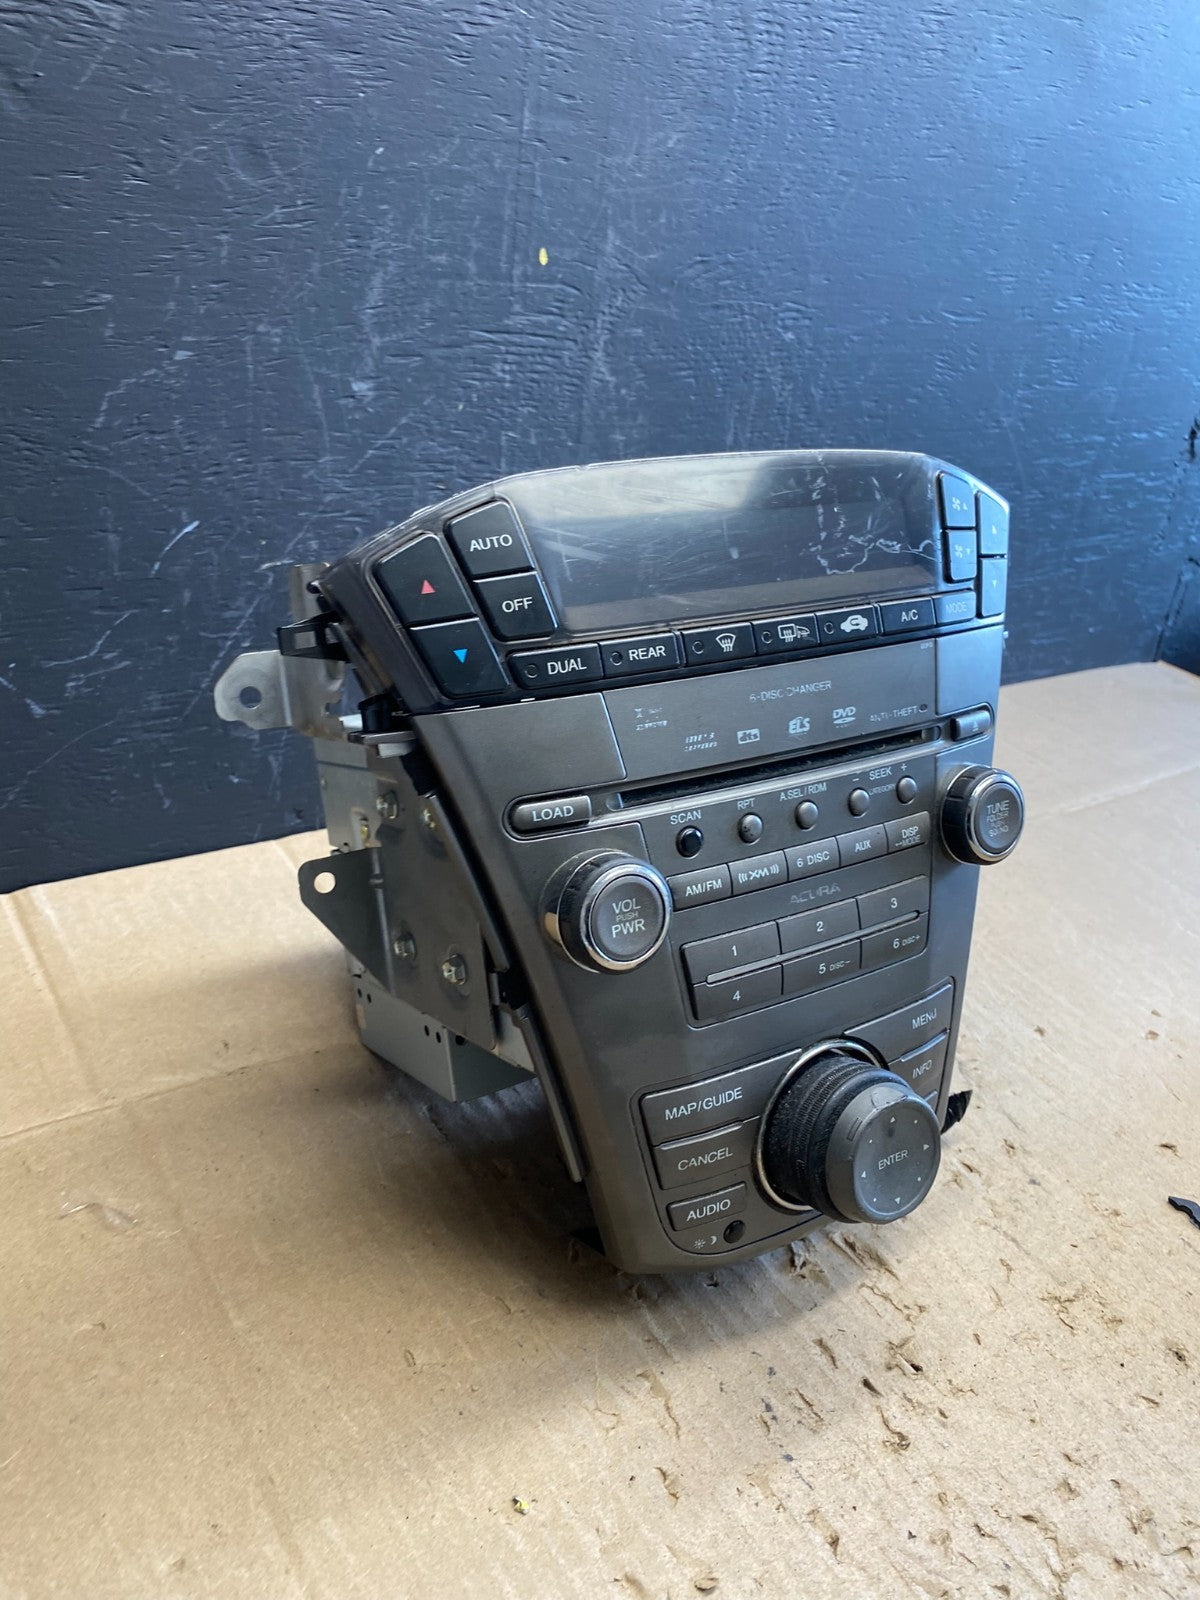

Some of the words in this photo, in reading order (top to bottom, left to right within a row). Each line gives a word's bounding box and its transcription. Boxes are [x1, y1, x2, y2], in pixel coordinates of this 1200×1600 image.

[469, 534, 513, 552] AUTO
[501, 597, 533, 613] OFF
[945, 600, 968, 614] MODE
[900, 608, 919, 622] A/C
[628, 645, 666, 661] REAR
[547, 657, 587, 675] DUAL
[869, 766, 893, 781] SEEK
[736, 798, 756, 811] RPT
[986, 800, 1010, 815] TUNE
[532, 805, 574, 823] LOAD
[669, 809, 702, 825] SCAN
[901, 825, 919, 839] DISP
[854, 840, 872, 852] AUX
[796, 858, 804, 868] 6
[807, 850, 830, 866] DISC
[685, 878, 723, 896] AM/FM
[612, 898, 641, 914] VOL
[890, 897, 898, 909] 3
[611, 918, 645, 938] PWR
[816, 920, 824, 933] 2
[731, 944, 738, 958] 1
[893, 937, 900, 949] 6
[818, 962, 826, 975] 5
[732, 989, 742, 1002] 4
[912, 1060, 933, 1079] INFO
[664, 1086, 744, 1121] MAP/GUIDE
[677, 1147, 733, 1172] CANCEL
[877, 1149, 909, 1170] ENTER
[686, 1199, 732, 1222] AUDIO
